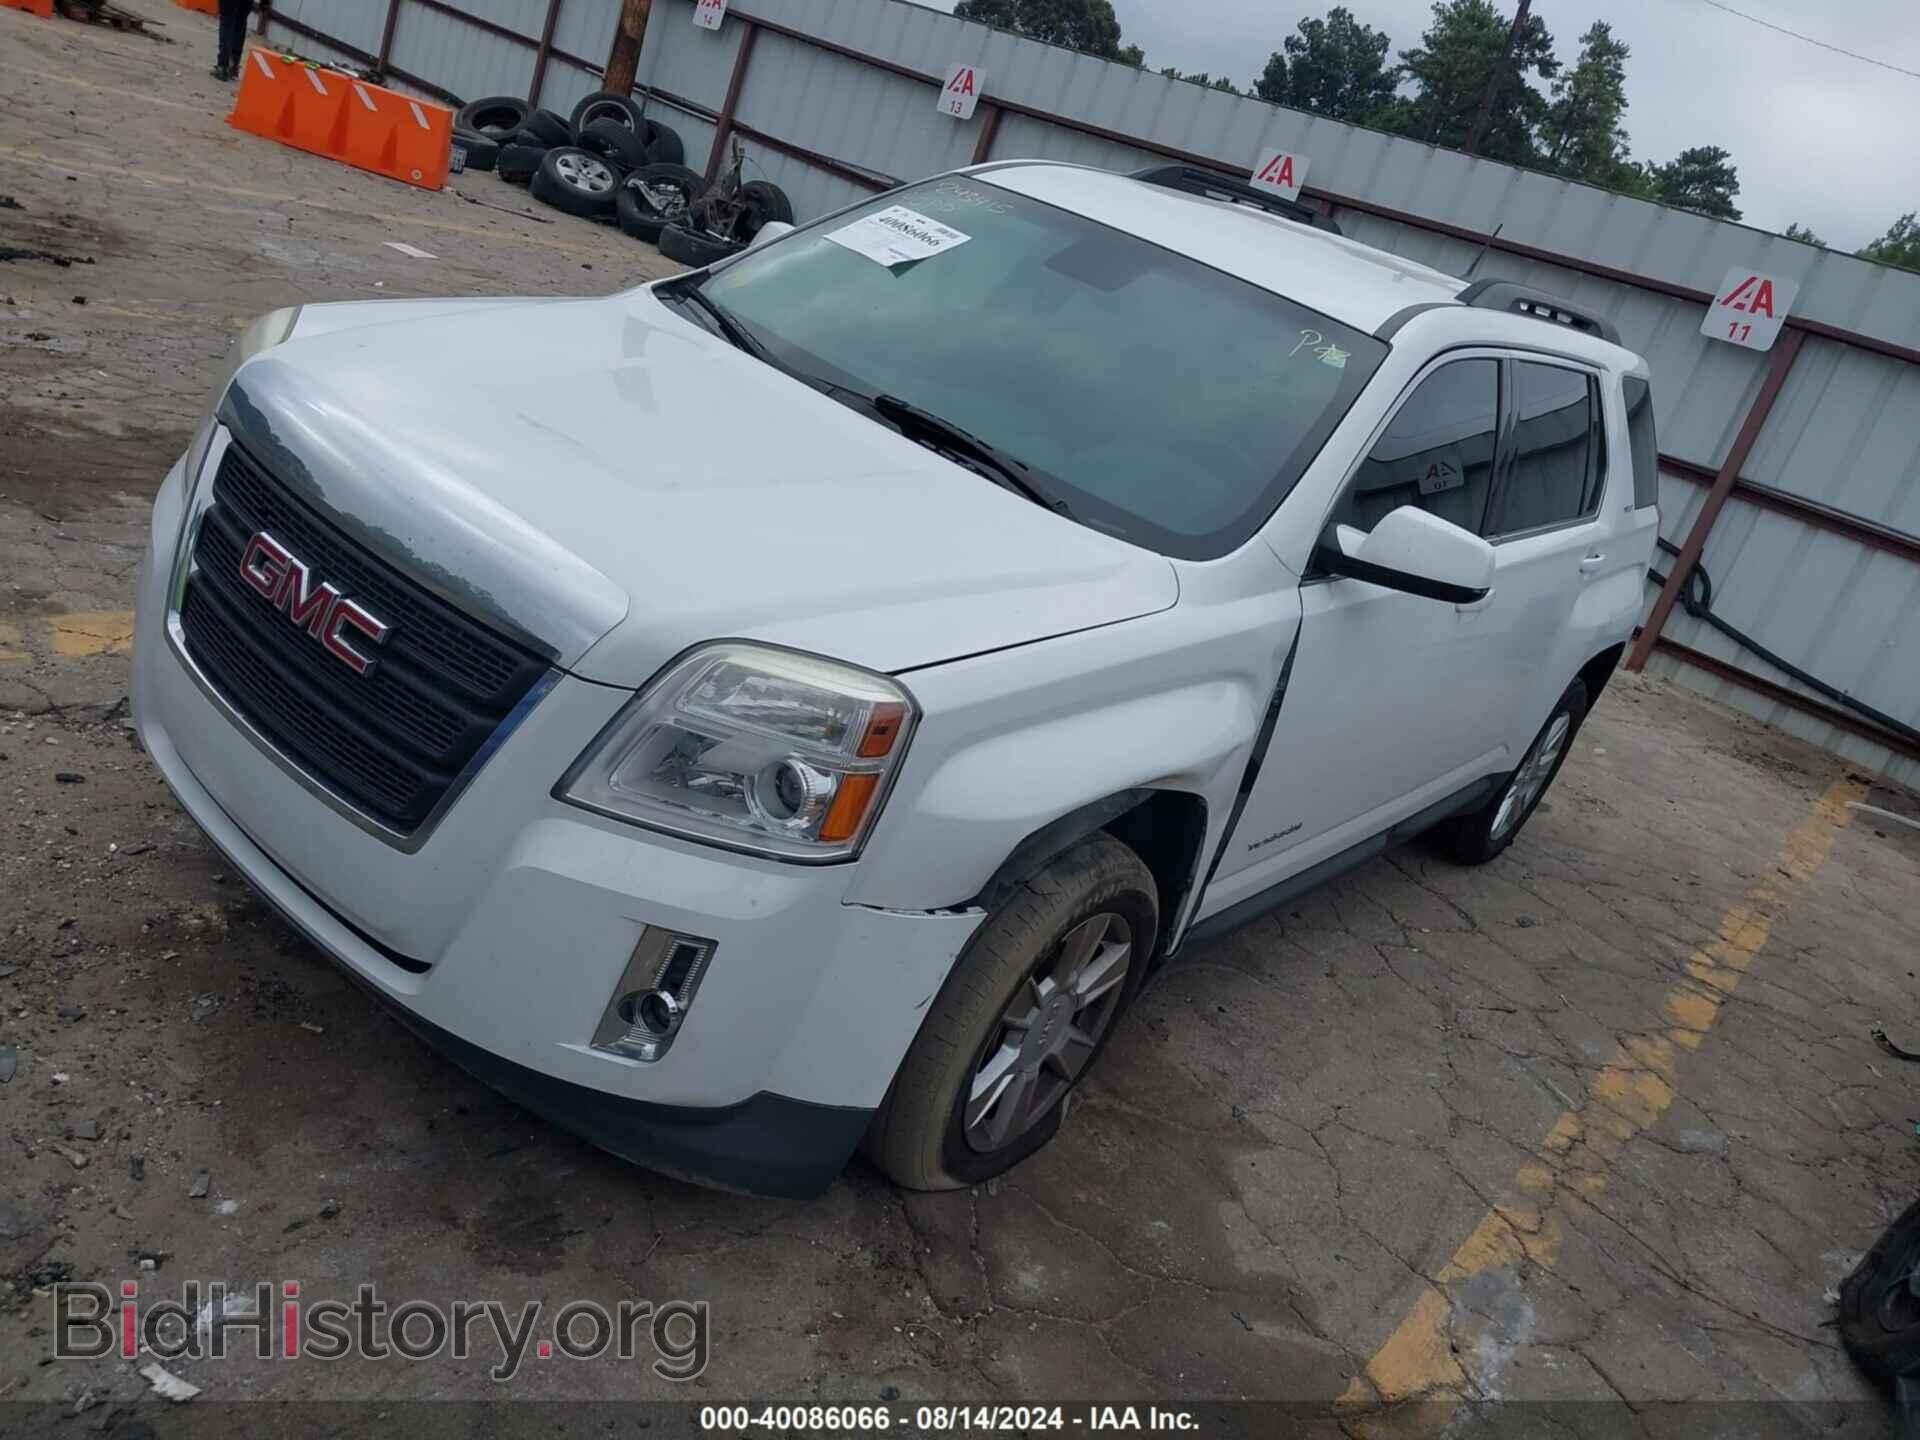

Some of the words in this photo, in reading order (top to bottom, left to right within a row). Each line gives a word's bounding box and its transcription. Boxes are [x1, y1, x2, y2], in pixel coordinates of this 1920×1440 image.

[950, 100, 963, 114] 13
[1728, 321, 1752, 341] 11
[240, 531, 388, 674] GMC
